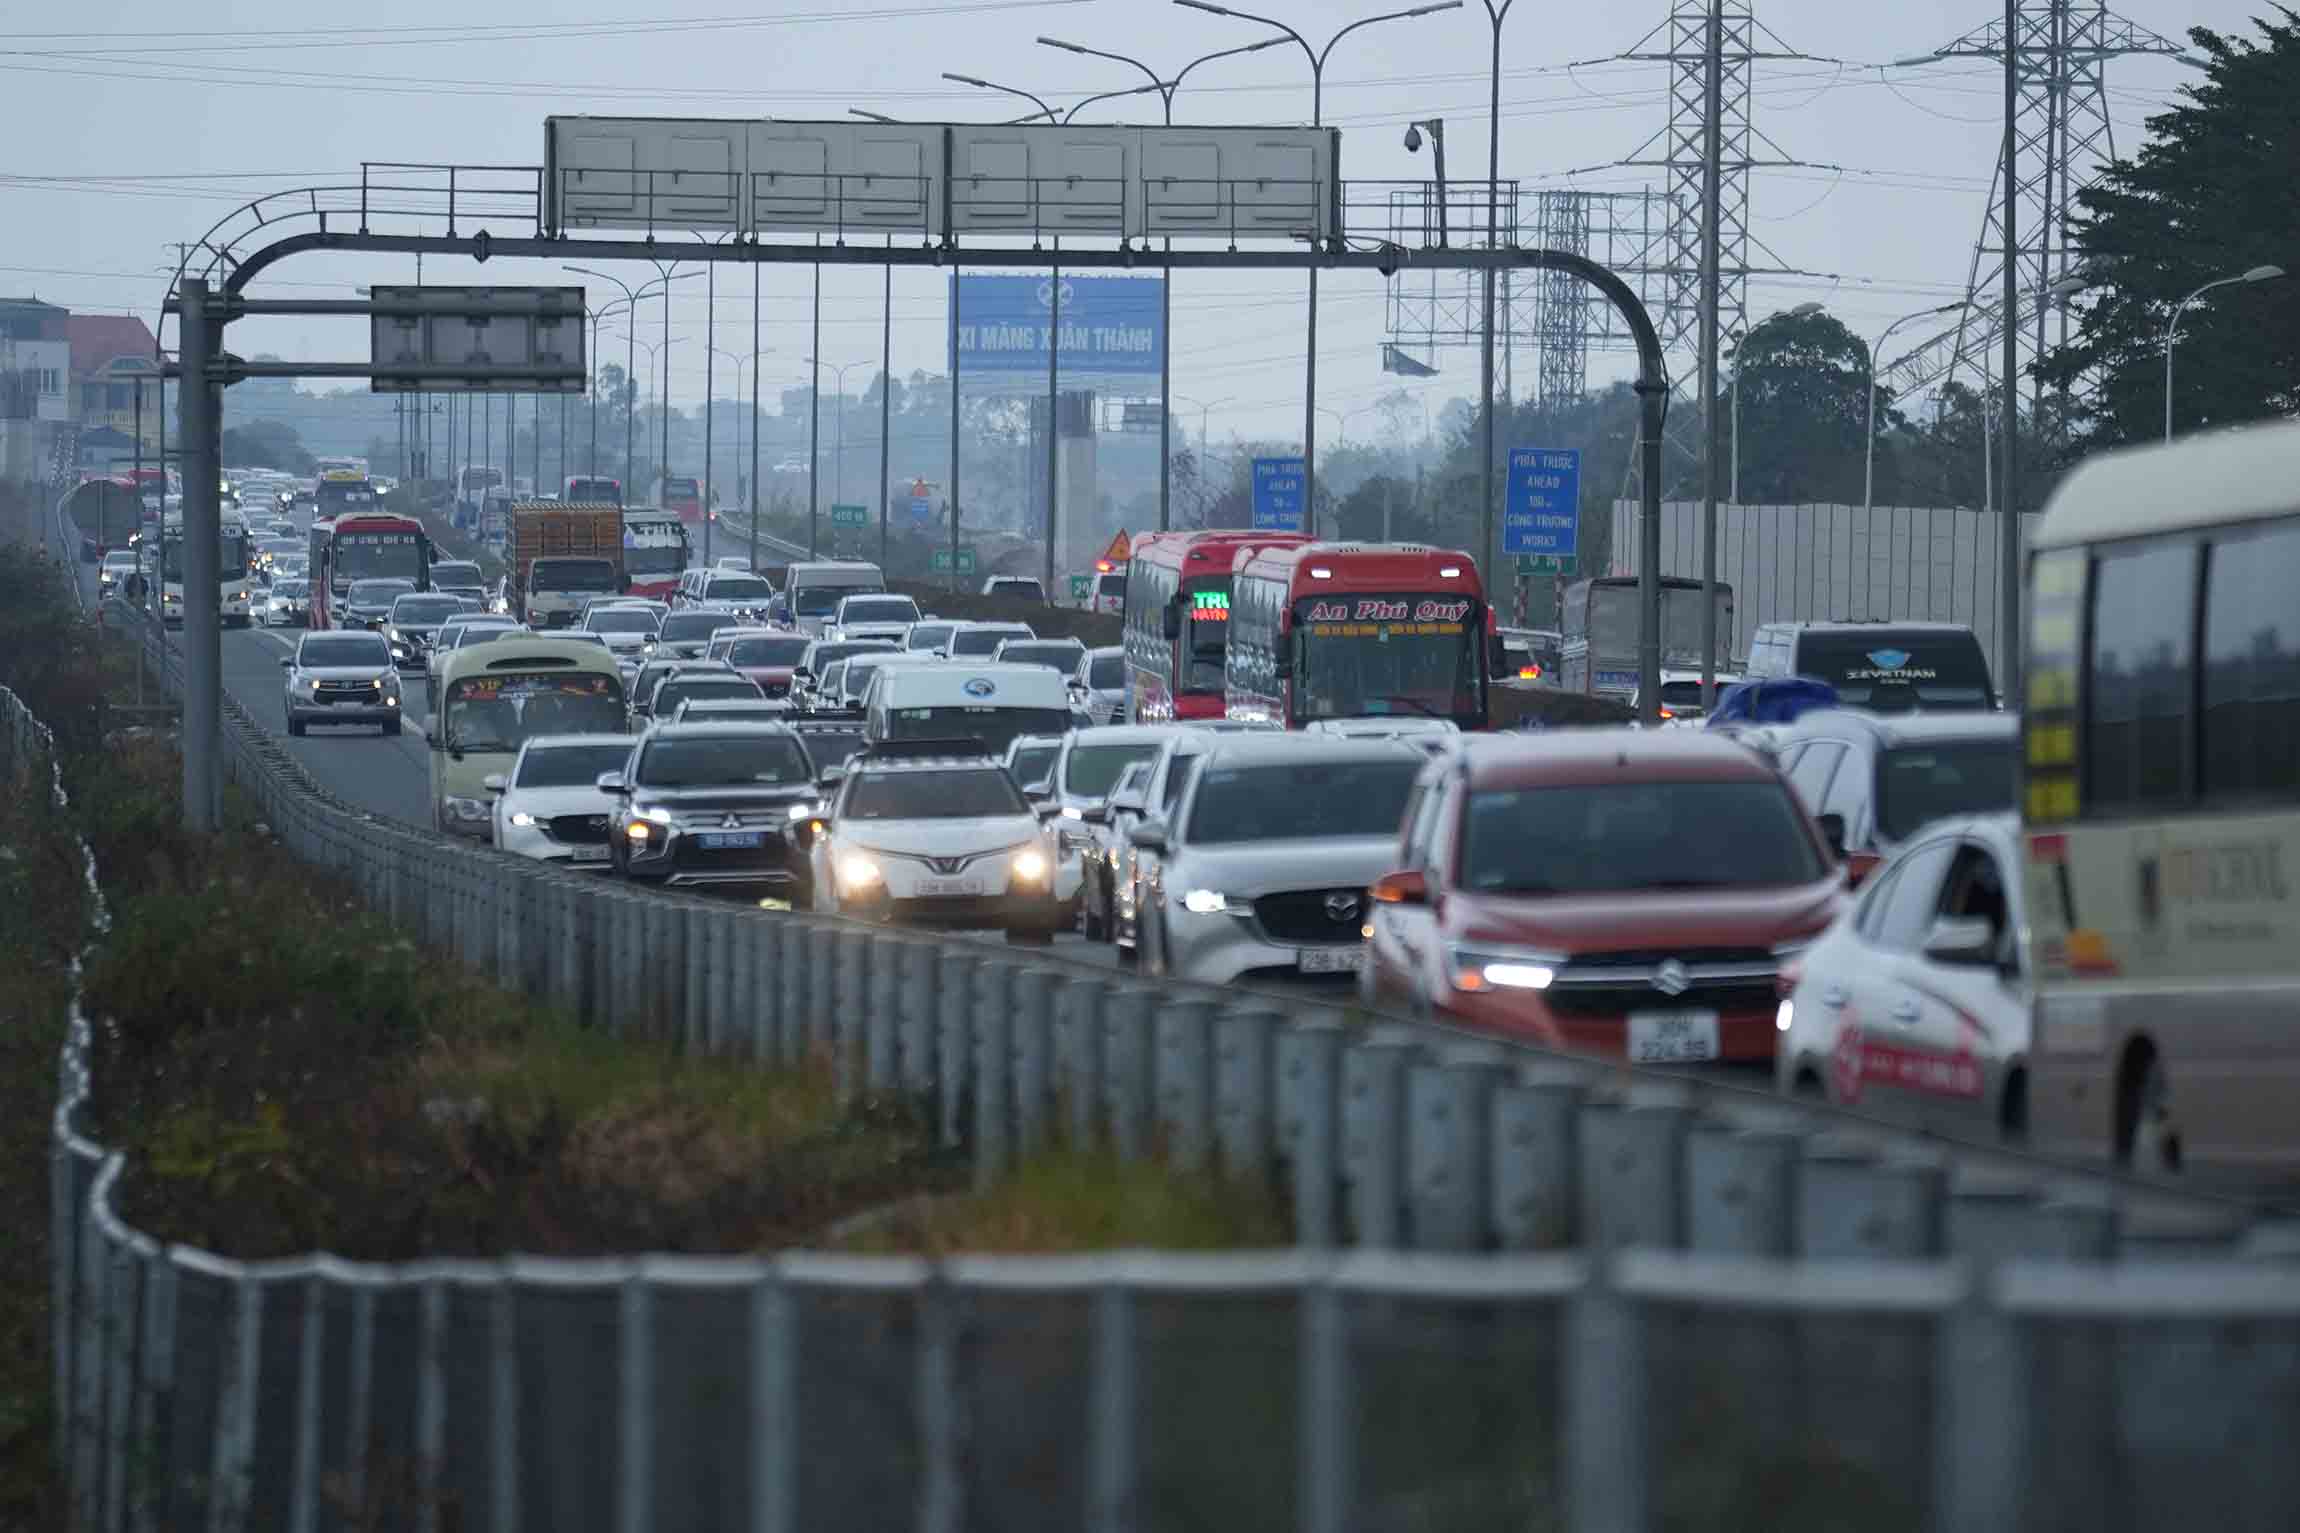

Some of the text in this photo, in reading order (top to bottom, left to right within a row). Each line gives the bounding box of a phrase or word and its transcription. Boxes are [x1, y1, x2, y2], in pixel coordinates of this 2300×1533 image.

[981, 321, 1034, 352] MĂNG
[1527, 475, 1560, 489] AHEAD
[1521, 535, 1557, 548] WORKS
[1308, 600, 1470, 623] An Phú Quý
